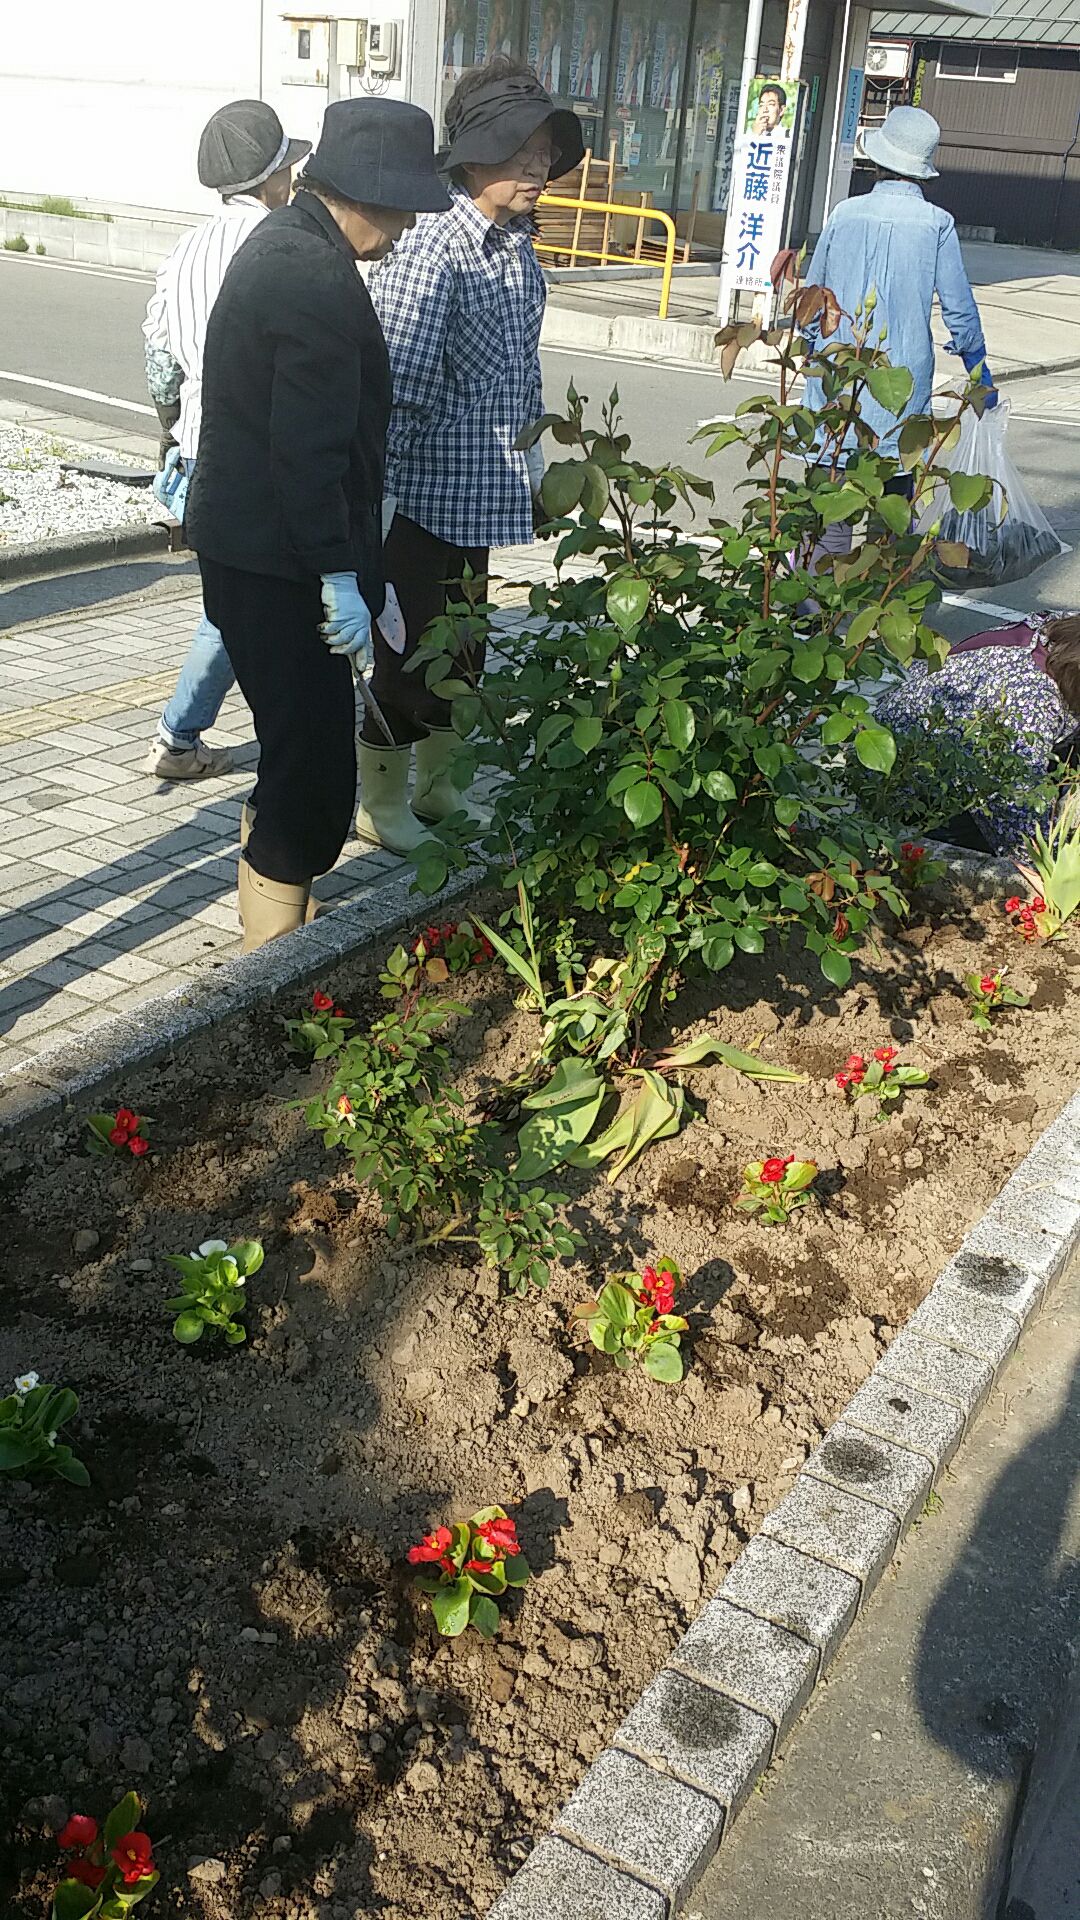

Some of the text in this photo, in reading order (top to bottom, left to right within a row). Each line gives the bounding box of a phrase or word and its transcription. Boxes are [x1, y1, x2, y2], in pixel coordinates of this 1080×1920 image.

[846, 74, 859, 139] KUMON
[736, 141, 774, 271] 近藤 洋介
